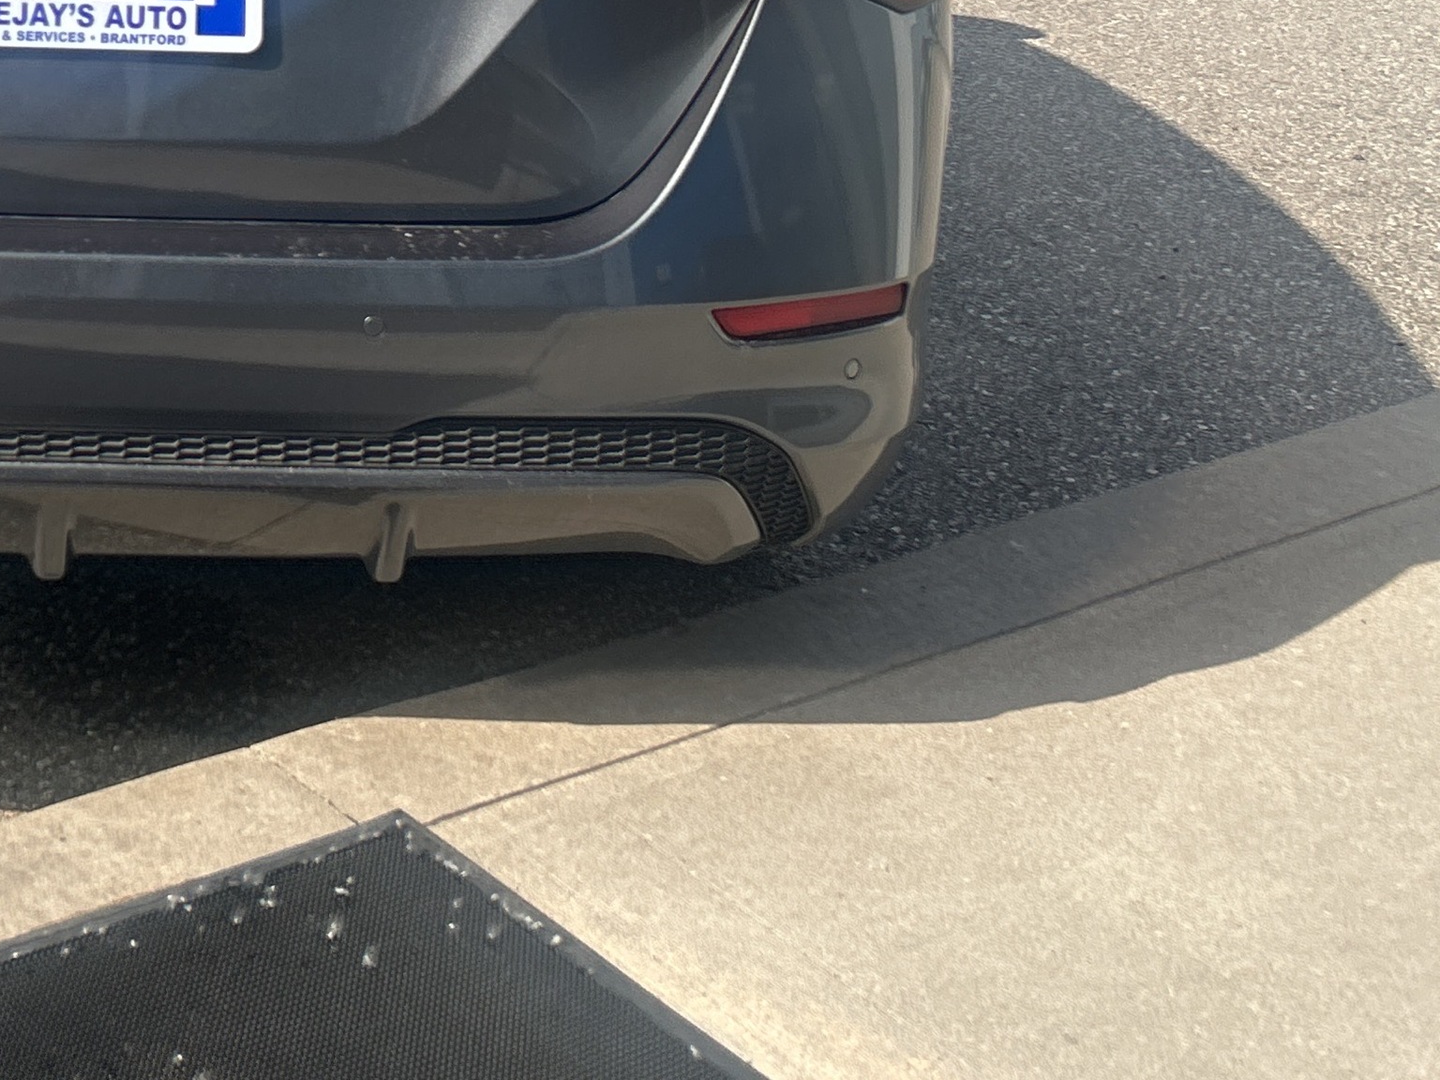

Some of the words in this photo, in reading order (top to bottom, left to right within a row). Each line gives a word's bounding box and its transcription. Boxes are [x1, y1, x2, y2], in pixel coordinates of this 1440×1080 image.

[105, 4, 187, 31] AUTO
[1, 30, 12, 41] &
[16, 30, 86, 43] SERVICES
[100, 33, 186, 46] BRANTFORD
